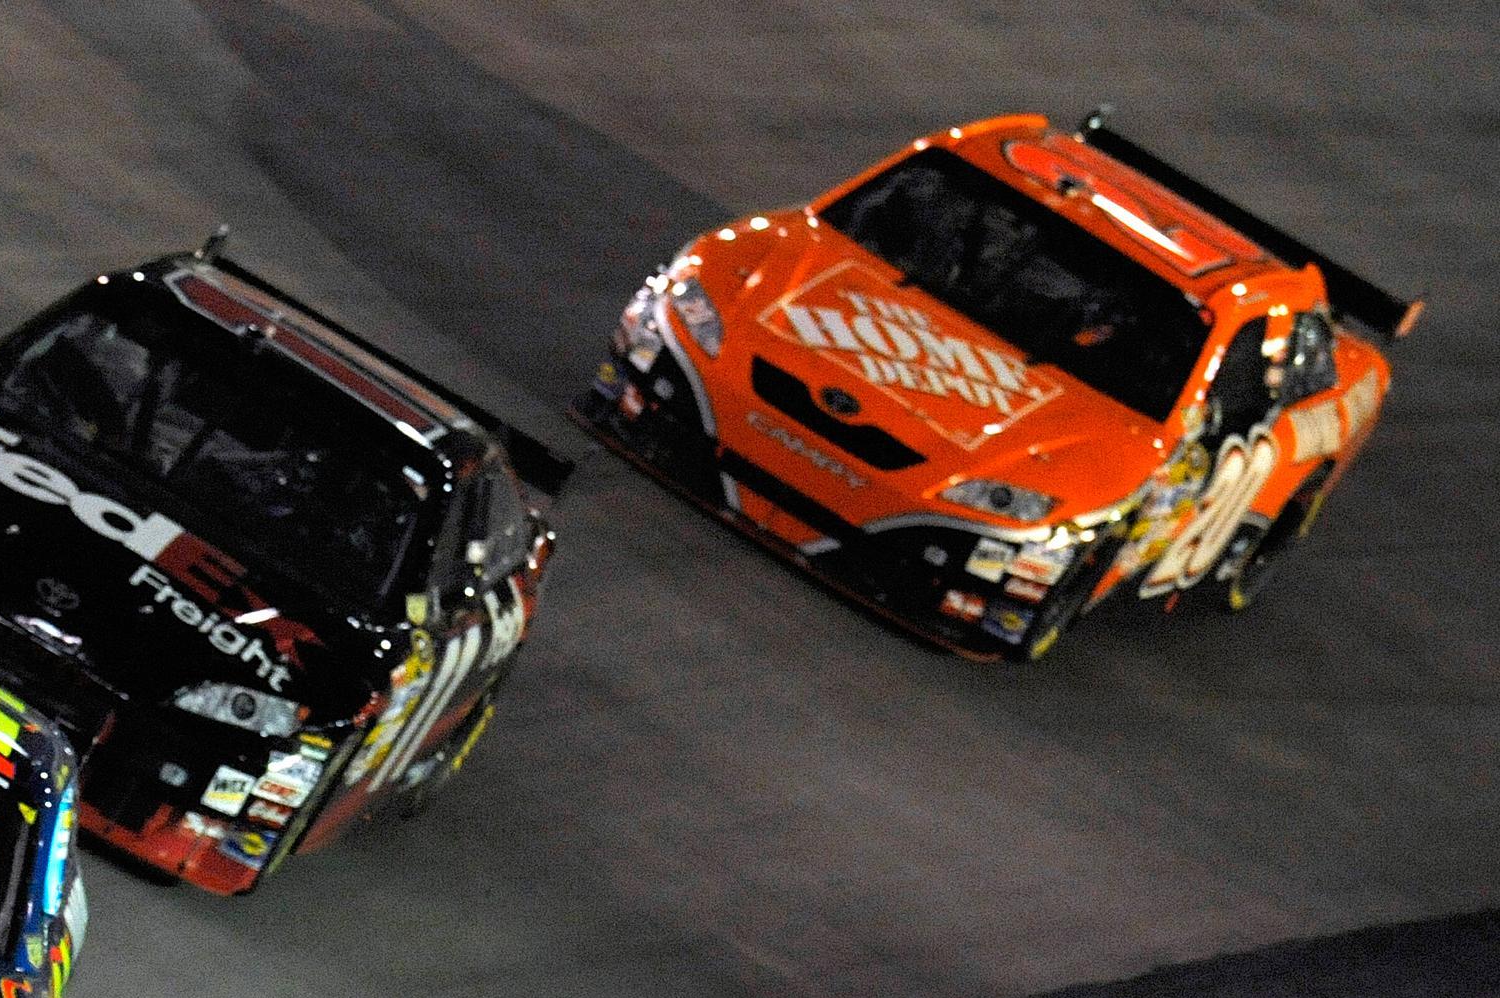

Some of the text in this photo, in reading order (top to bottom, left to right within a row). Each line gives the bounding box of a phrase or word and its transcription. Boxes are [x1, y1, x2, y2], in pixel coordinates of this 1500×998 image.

[784, 304, 1028, 393] HOME
[857, 353, 1015, 416] DEPOT
[128, 565, 292, 692] Freight
